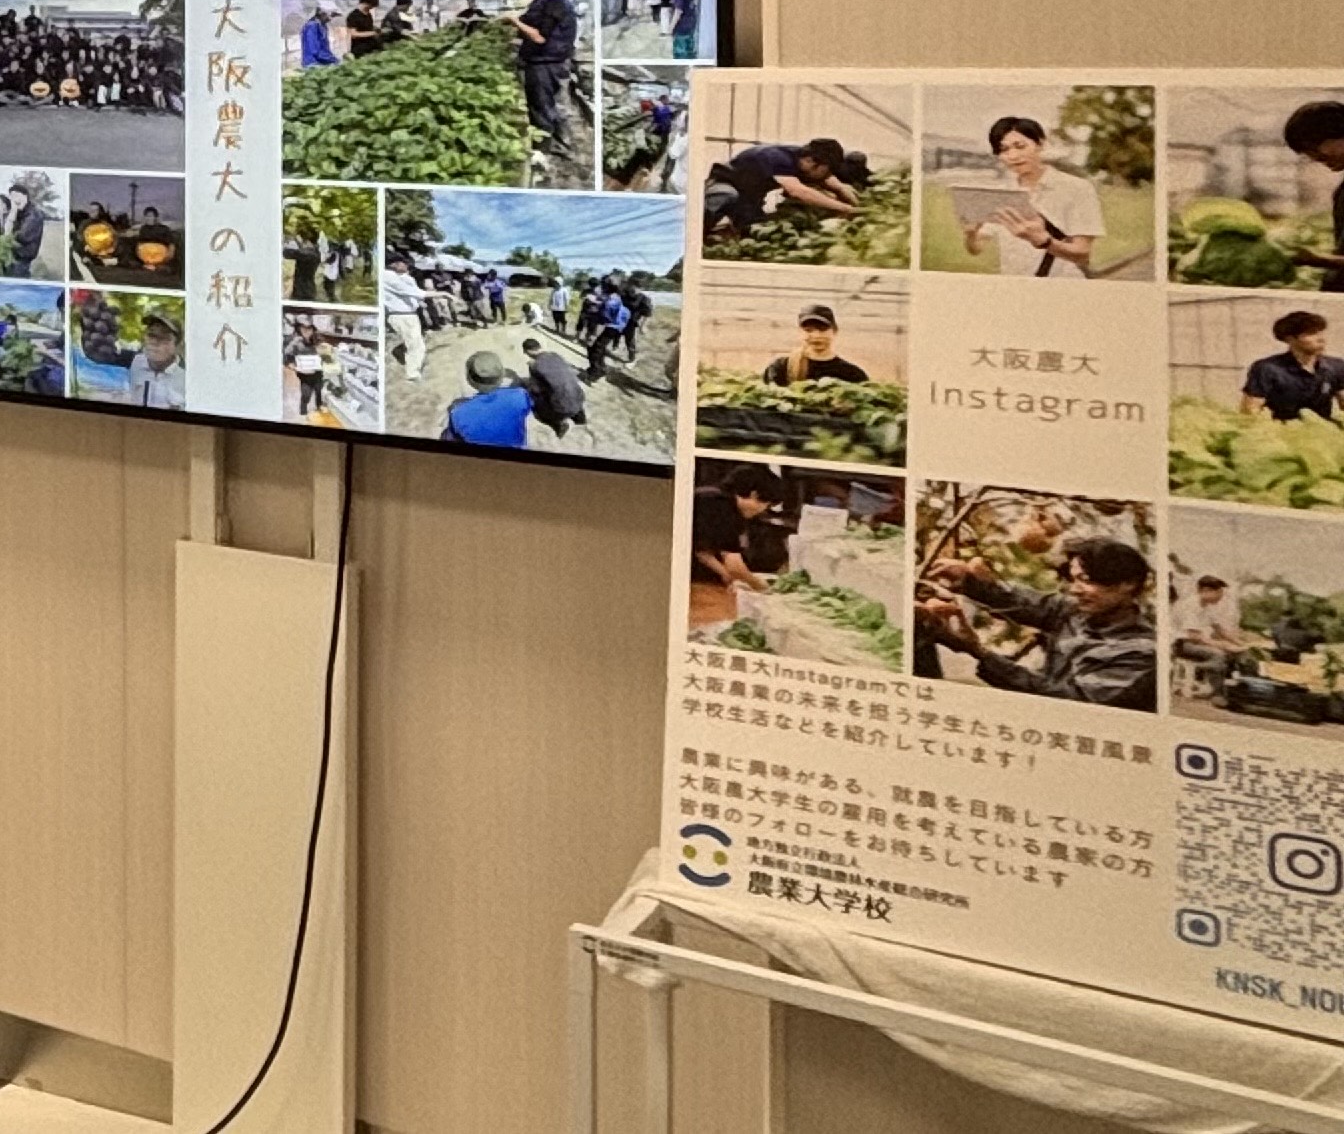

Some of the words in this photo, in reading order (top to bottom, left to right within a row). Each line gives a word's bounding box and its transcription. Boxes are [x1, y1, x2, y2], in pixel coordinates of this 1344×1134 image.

[970, 346, 1101, 378] 大阪農大
[928, 380, 1147, 423] Instagram
[681, 698, 1037, 772] 学校生活などを紹介しています！
[683, 673, 1153, 766] 大阪農業の未来を担う学生たちの実習風景
[679, 773, 1155, 878] 大阪農大学生の雇用を考えている農家の方
[679, 796, 1070, 889] 皆様のフォローをお待ちしています
[747, 870, 893, 924] 農業大学校
